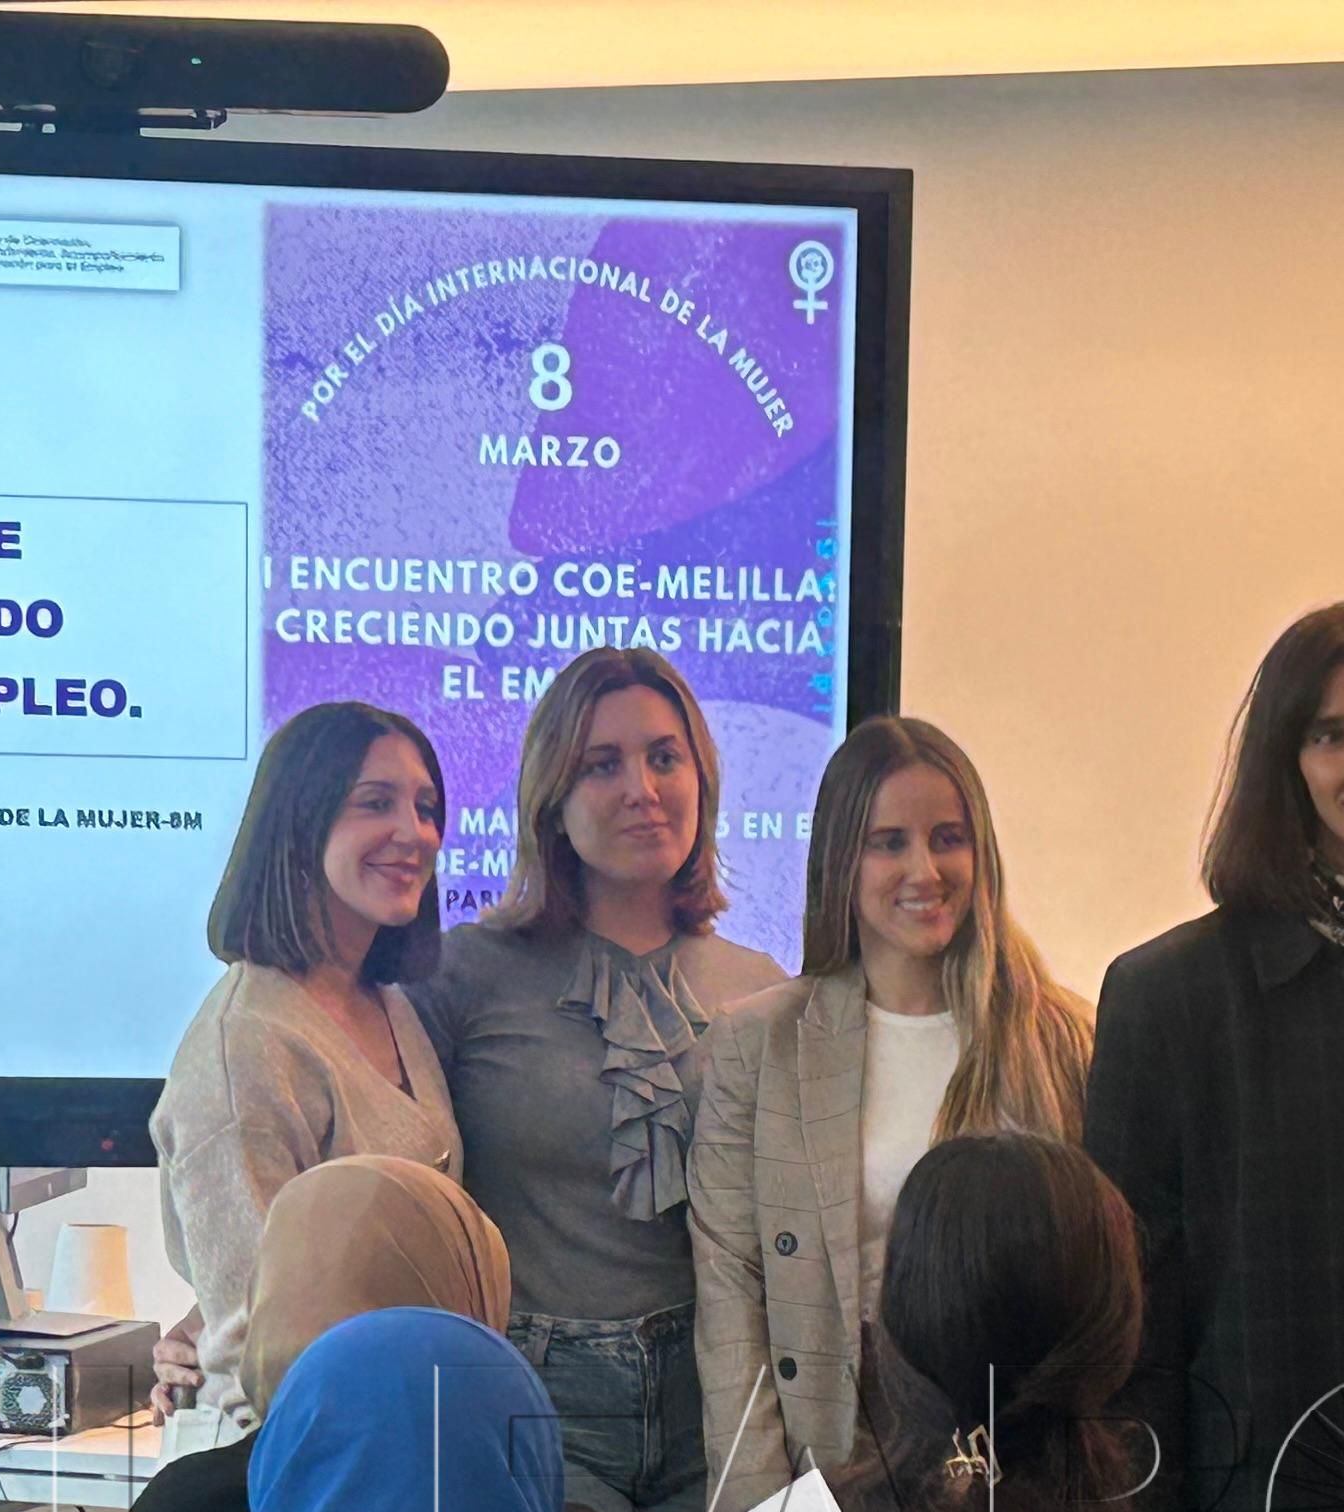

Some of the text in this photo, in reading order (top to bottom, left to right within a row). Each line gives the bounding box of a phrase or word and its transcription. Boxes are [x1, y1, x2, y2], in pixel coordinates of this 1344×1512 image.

[301, 255, 794, 438] POR EL DÍA INTERNACIONAL DE LA MUJER
[529, 343, 573, 411] 8
[479, 434, 621, 469] MARZO
[290, 555, 538, 596] ENCUENTRO
[276, 608, 824, 655] CRECIENDO JUNTAS HACIA
[443, 665, 484, 699] EL
[39, 808, 69, 827] LA
[743, 812, 782, 839] EN
